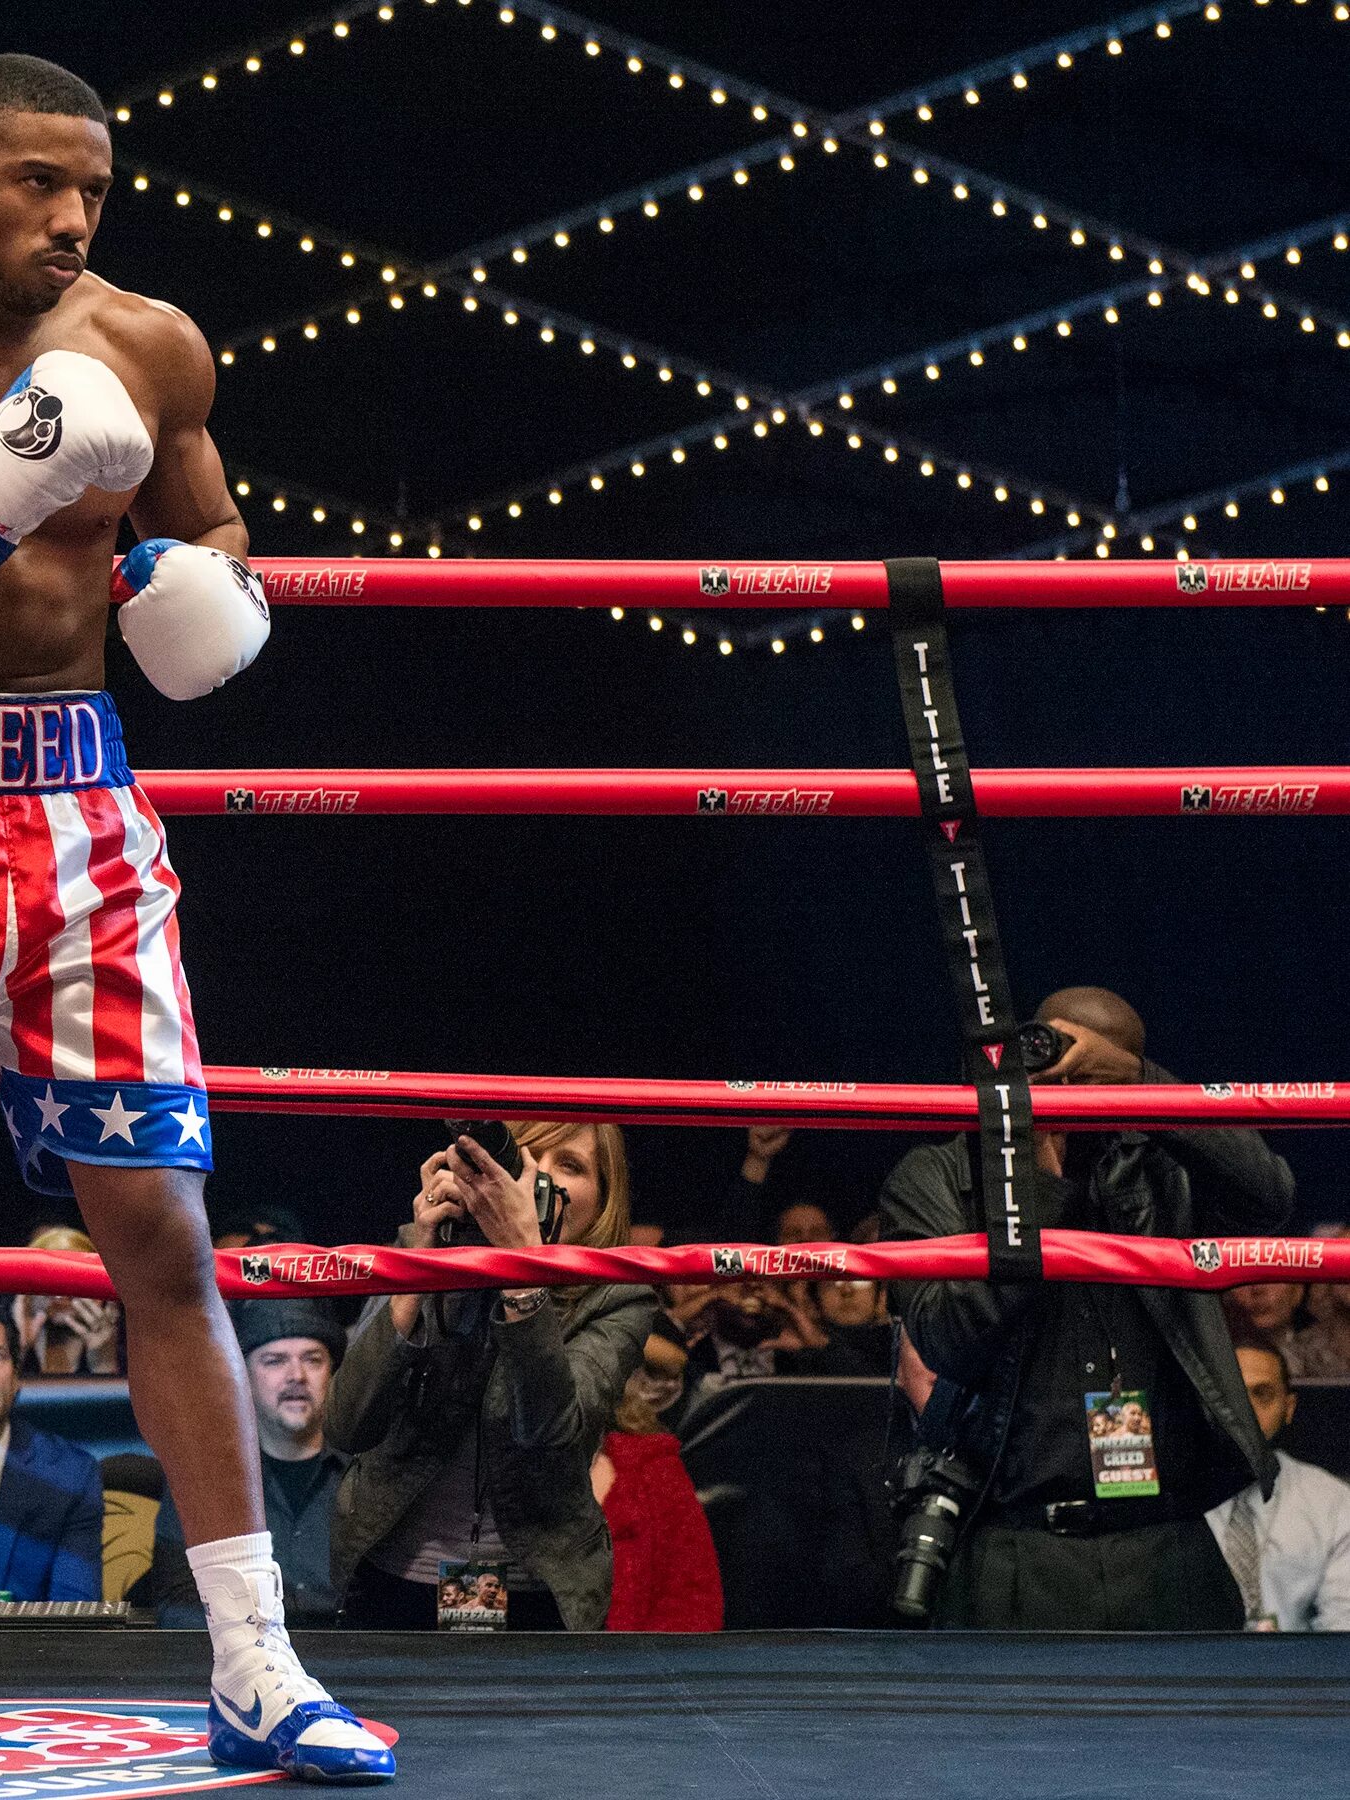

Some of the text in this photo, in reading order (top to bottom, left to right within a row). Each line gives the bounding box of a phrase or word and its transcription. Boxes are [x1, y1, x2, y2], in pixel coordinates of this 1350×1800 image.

[266, 567, 367, 597] TECATE
[732, 565, 833, 594] TECATE
[1210, 562, 1312, 592] TECATE
[913, 642, 954, 804] TITLE
[258, 788, 360, 814] TECATE
[730, 788, 834, 815] TECATE
[1215, 783, 1319, 813] TECATE
[950, 862, 995, 1026] TITLE
[995, 1084, 1022, 1246] TITLE
[274, 1251, 375, 1283] TECATE
[746, 1247, 847, 1275] TECATE
[1222, 1239, 1324, 1268] TECATE
[319, 1702, 341, 1713] NIKE
